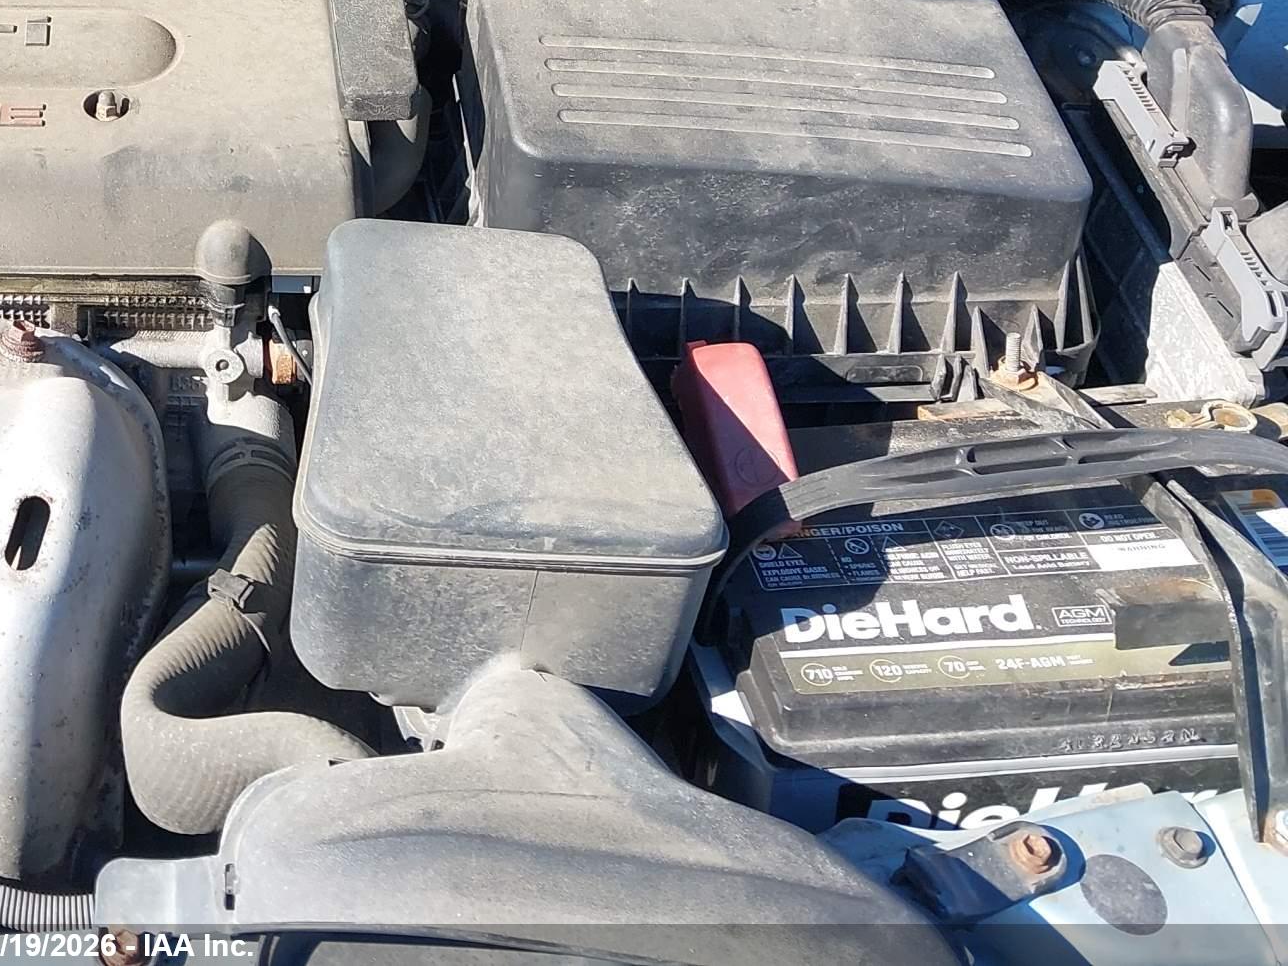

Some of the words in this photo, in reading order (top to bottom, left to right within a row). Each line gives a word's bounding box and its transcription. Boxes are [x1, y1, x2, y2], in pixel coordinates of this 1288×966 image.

[1059, 608, 1105, 618] AGM
[943, 660, 966, 673] 70
[995, 655, 1065, 671] 24F-AGM
[805, 669, 834, 680] 710
[874, 664, 903, 677] 120
